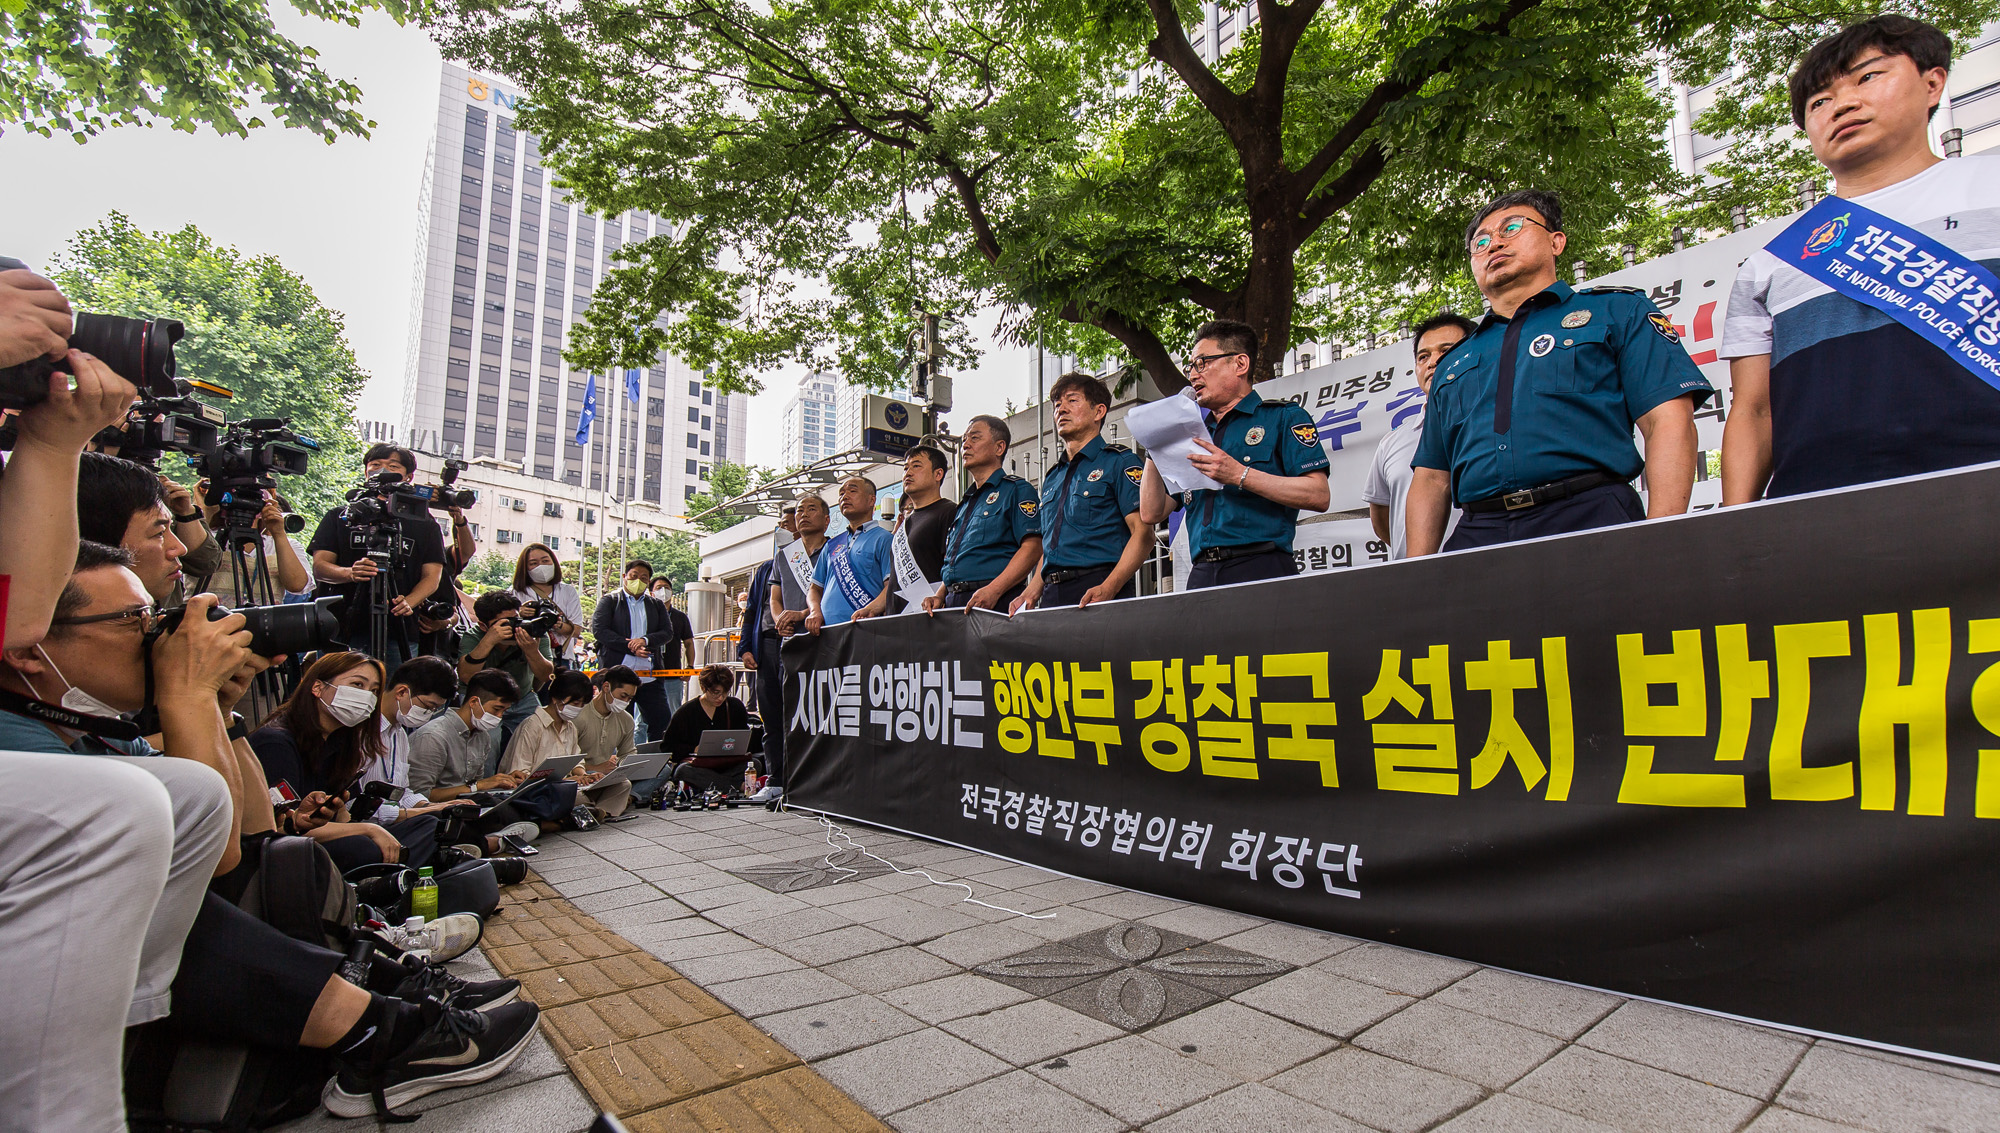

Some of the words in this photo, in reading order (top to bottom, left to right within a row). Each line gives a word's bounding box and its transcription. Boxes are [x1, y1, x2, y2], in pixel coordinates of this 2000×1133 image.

[1316, 367, 1395, 409] 민주성
[1649, 279, 1683, 311] 성
[1826, 258, 1852, 279] THE
[1846, 270, 1913, 309] NATIONAL
[1909, 301, 1964, 340] POLICE
[839, 581, 851, 597] POLICE
[26, 702, 80, 725] Canon
[791, 665, 862, 737] 시대를
[869, 661, 985, 749] 역행하는
[989, 661, 1122, 766] 행안부
[1131, 651, 1340, 788] 경찰국
[1362, 636, 1575, 802] 설치
[960, 783, 1214, 870] 전국경찰직장협의회
[1221, 829, 1363, 899] 회장단
